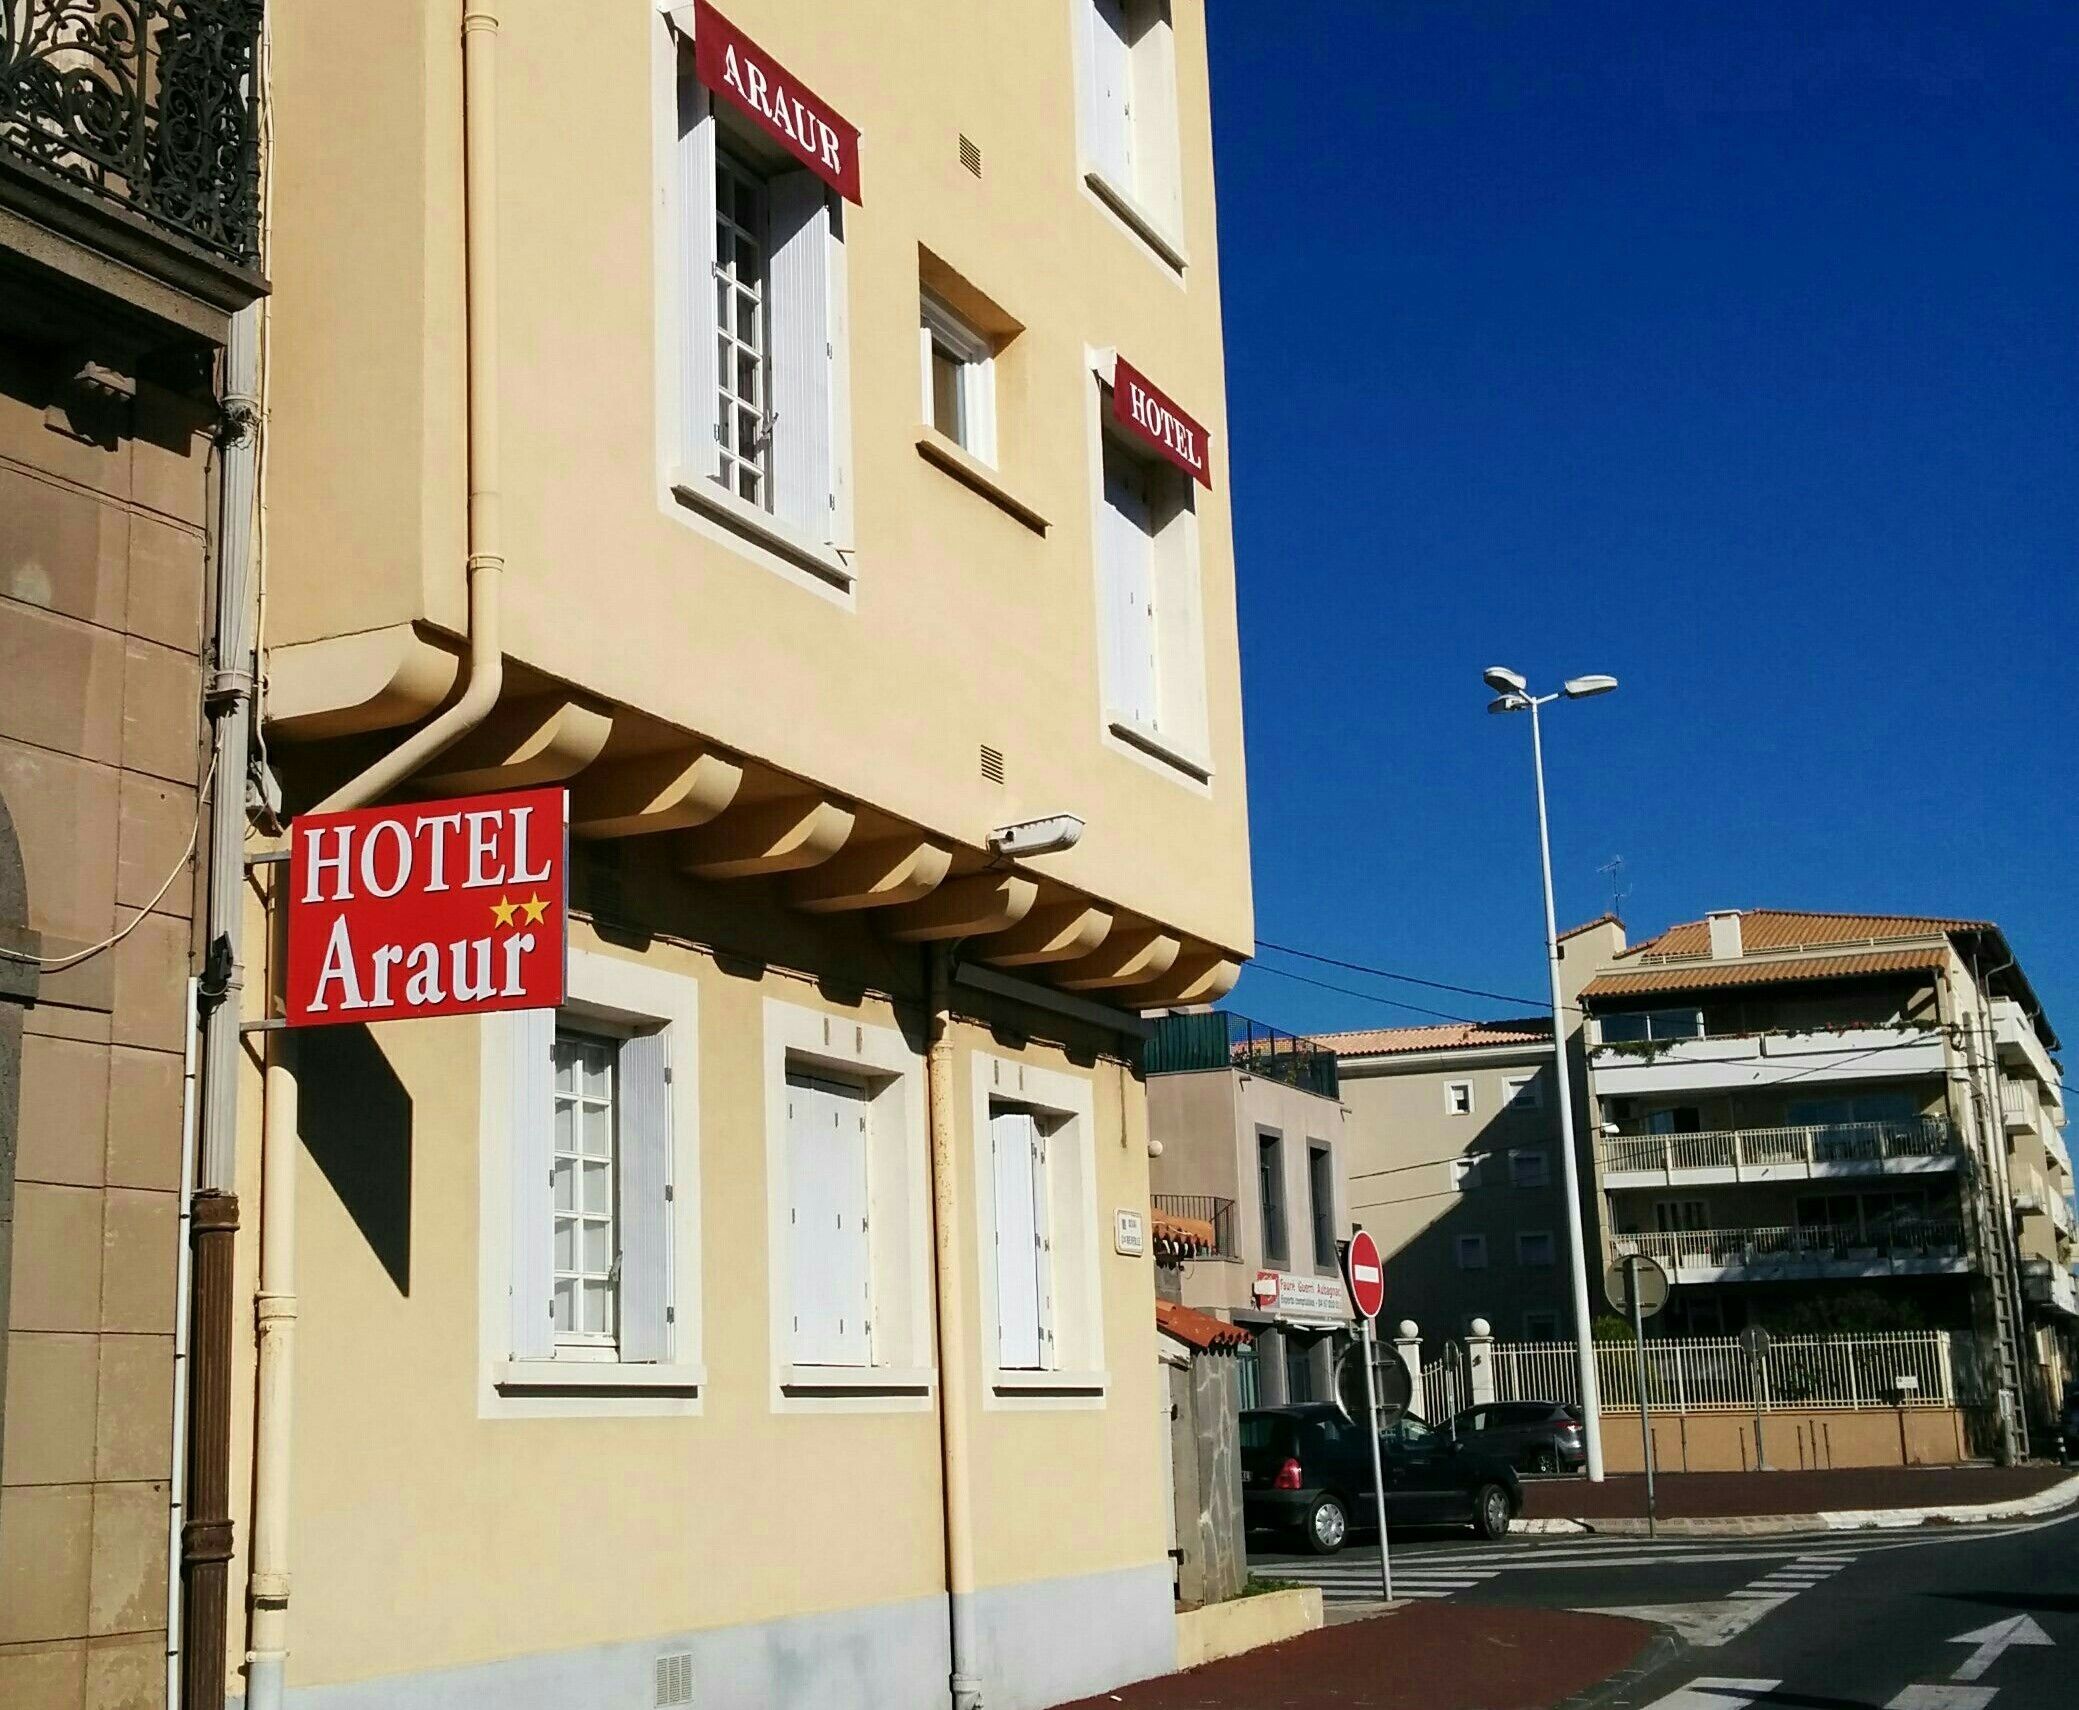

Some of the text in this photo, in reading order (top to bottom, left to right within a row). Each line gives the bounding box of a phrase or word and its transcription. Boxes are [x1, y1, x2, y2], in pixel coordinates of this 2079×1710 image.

[723, 43, 841, 175] ARAUR
[1129, 381, 1202, 469] HOTEL
[301, 806, 552, 904] HOTEL
[306, 913, 536, 1013] Araur
